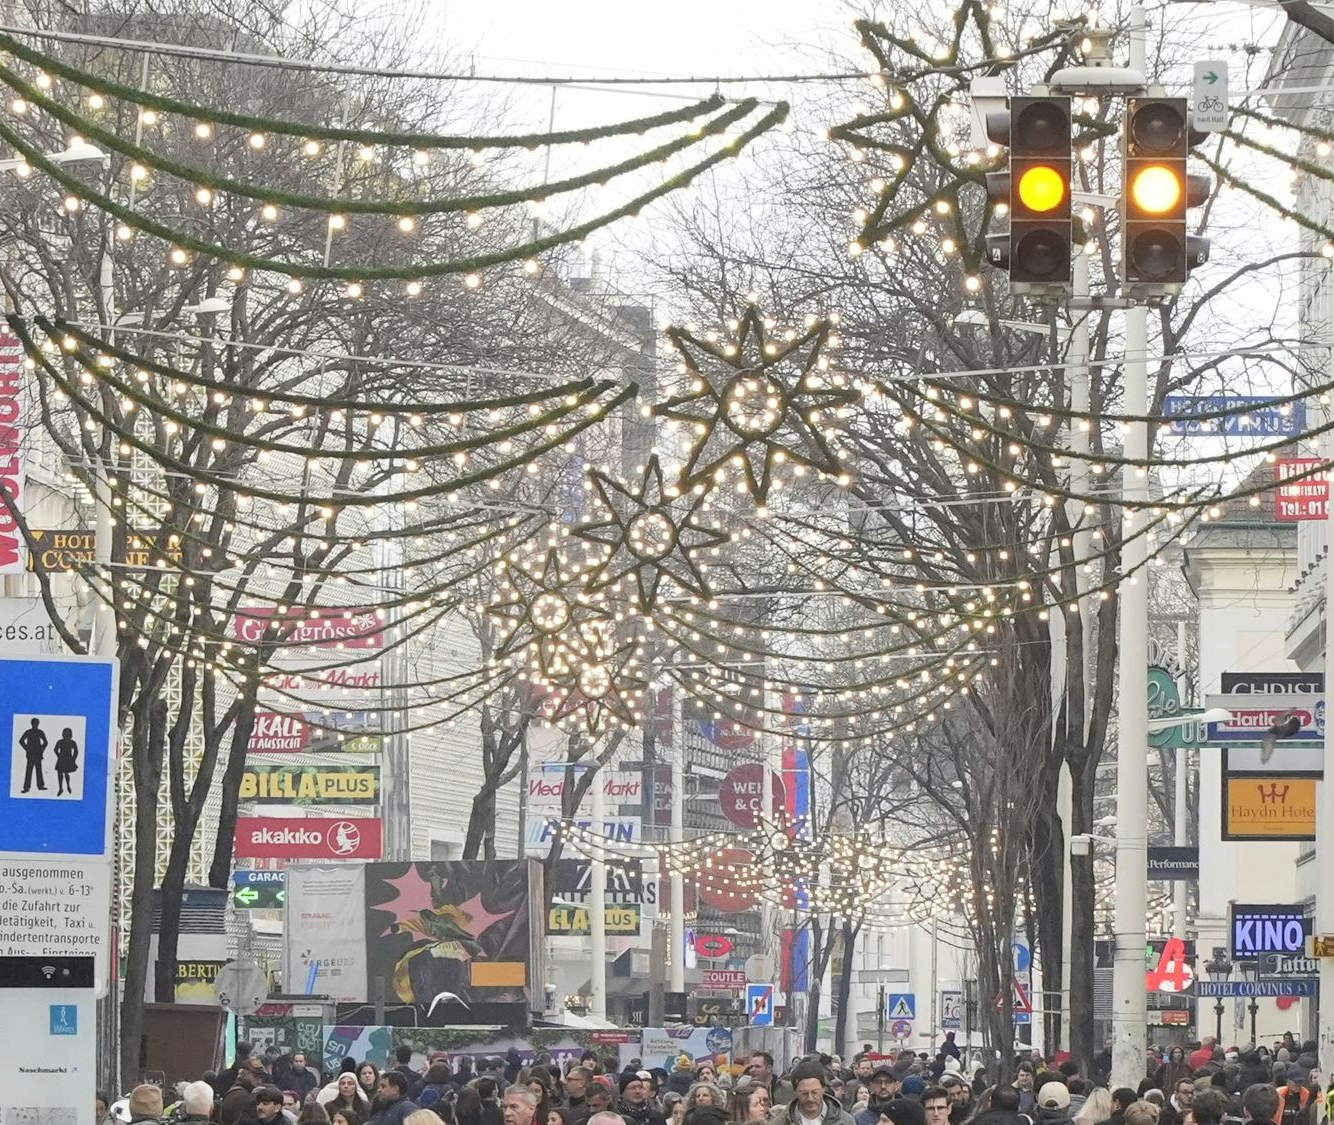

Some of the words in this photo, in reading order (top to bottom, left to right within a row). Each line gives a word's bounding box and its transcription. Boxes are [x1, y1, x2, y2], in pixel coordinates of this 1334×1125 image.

[238, 772, 318, 798] BILLA
[324, 778, 370, 793] PLUS
[733, 782, 764, 795] WEI
[1231, 803, 1277, 821] Haydn
[251, 827, 323, 845] akakiko
[2, 867, 84, 880] ausgenommen
[2, 900, 18, 911] die
[21, 900, 60, 912] Zufahrt
[64, 903, 81, 913] zur
[64, 917, 85, 928] Taxi
[1235, 921, 1304, 951] KINO
[1200, 983, 1236, 995] HOTEL
[1239, 983, 1293, 996] CORVINUS
[19, 1066, 67, 1074] Naschmarkt
